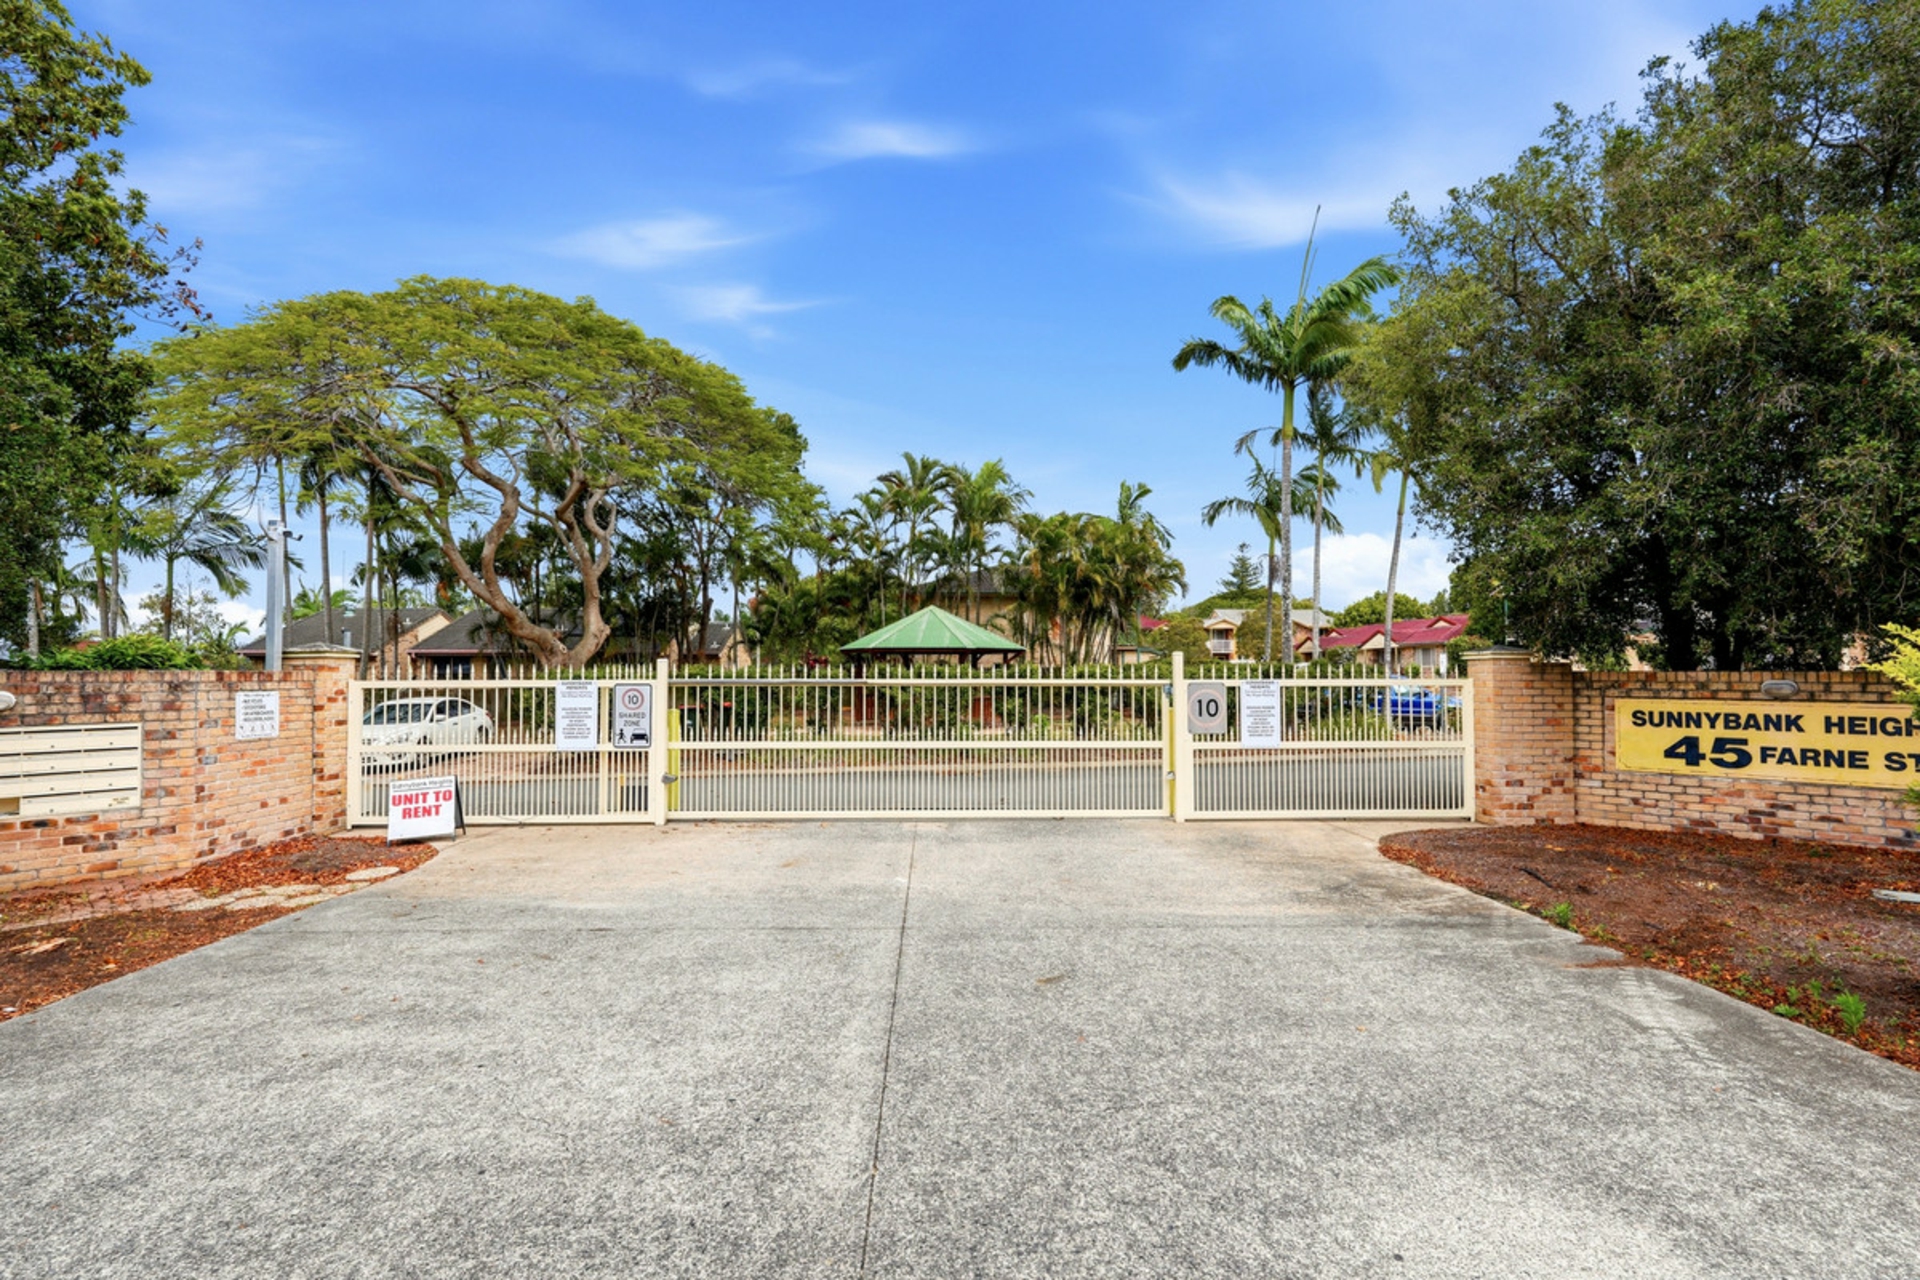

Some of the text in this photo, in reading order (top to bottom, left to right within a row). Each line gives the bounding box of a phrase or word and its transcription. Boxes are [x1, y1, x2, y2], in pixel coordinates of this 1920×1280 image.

[627, 694, 639, 705] 10
[1197, 699, 1219, 718] 10
[1631, 710, 1805, 733] SUNNYBANK
[1664, 736, 1753, 769] 45
[1760, 747, 1869, 770] FARNE
[392, 789, 452, 807] UNIT TO
[402, 804, 442, 820] RENT
